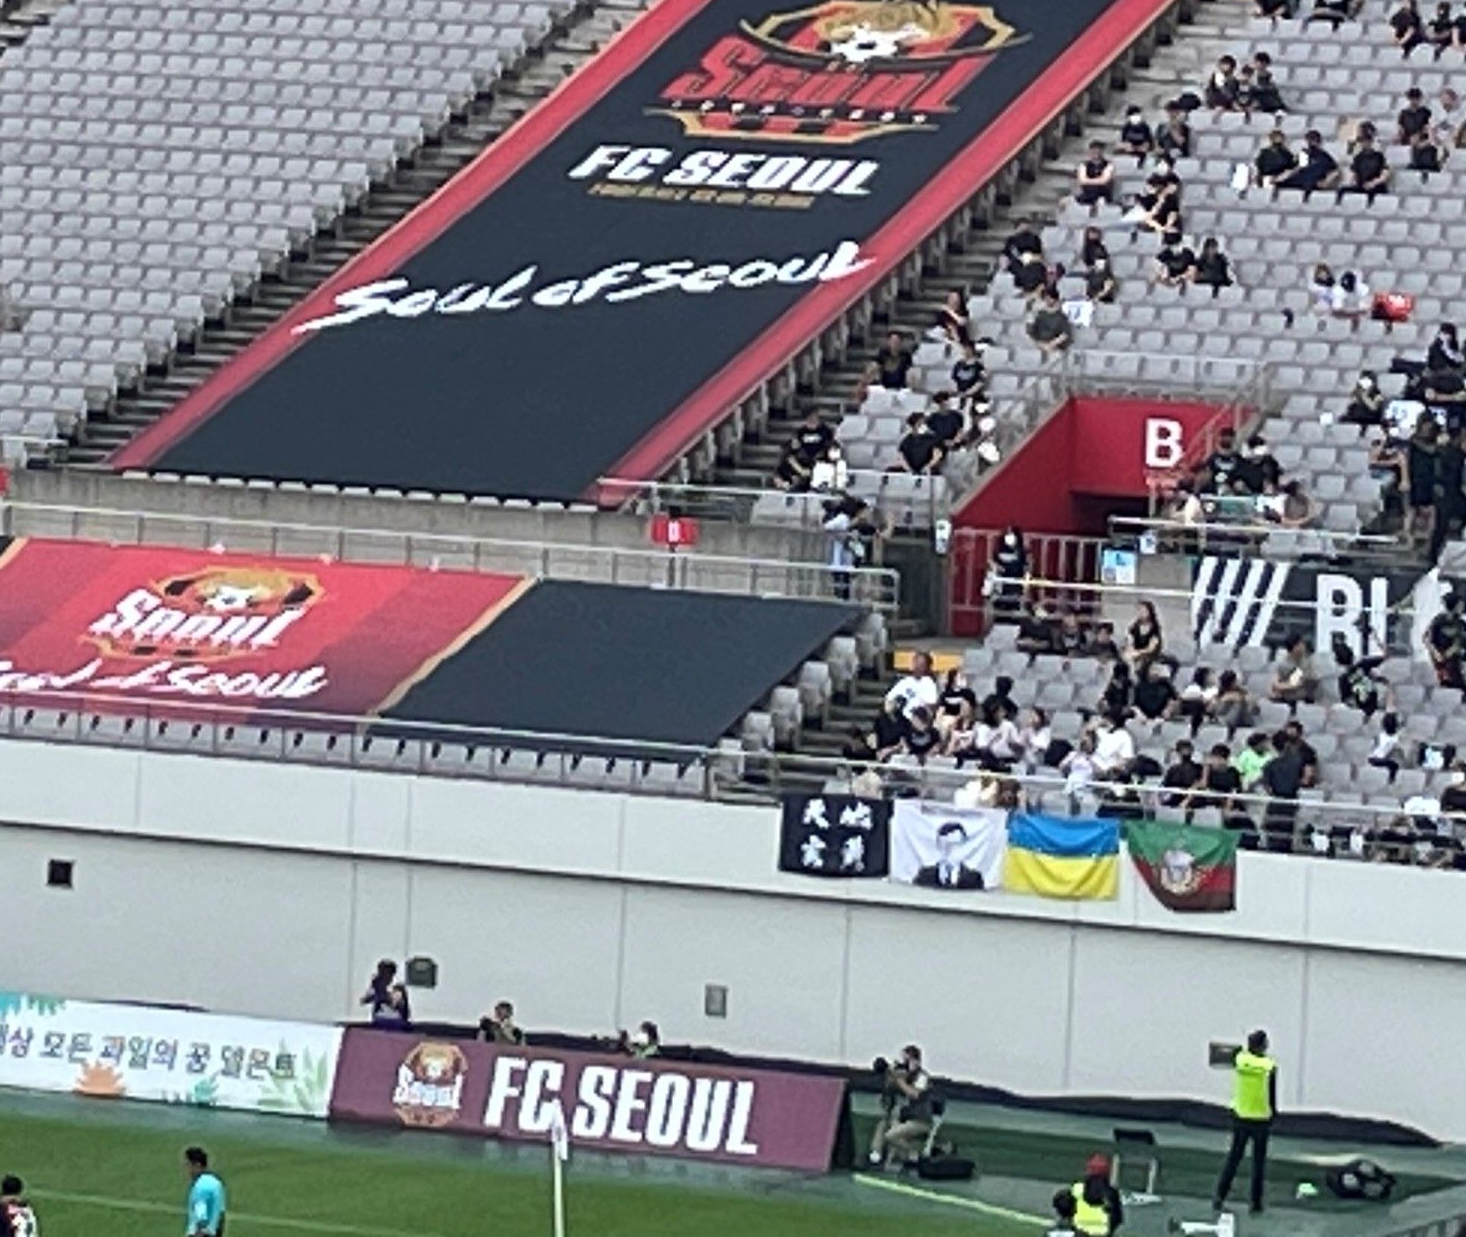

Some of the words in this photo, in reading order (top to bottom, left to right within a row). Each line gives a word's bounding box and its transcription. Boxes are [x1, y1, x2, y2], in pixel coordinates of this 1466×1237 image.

[568, 144, 673, 181] FC
[663, 151, 879, 196] SEOUL
[292, 265, 537, 336] Soul
[606, 241, 877, 303] Seoul
[1146, 419, 1184, 468] B
[39, 1031, 93, 1064] 모든
[100, 1035, 178, 1072] 과일의
[483, 1056, 563, 1133] FC
[572, 1066, 758, 1155] SEOUL
